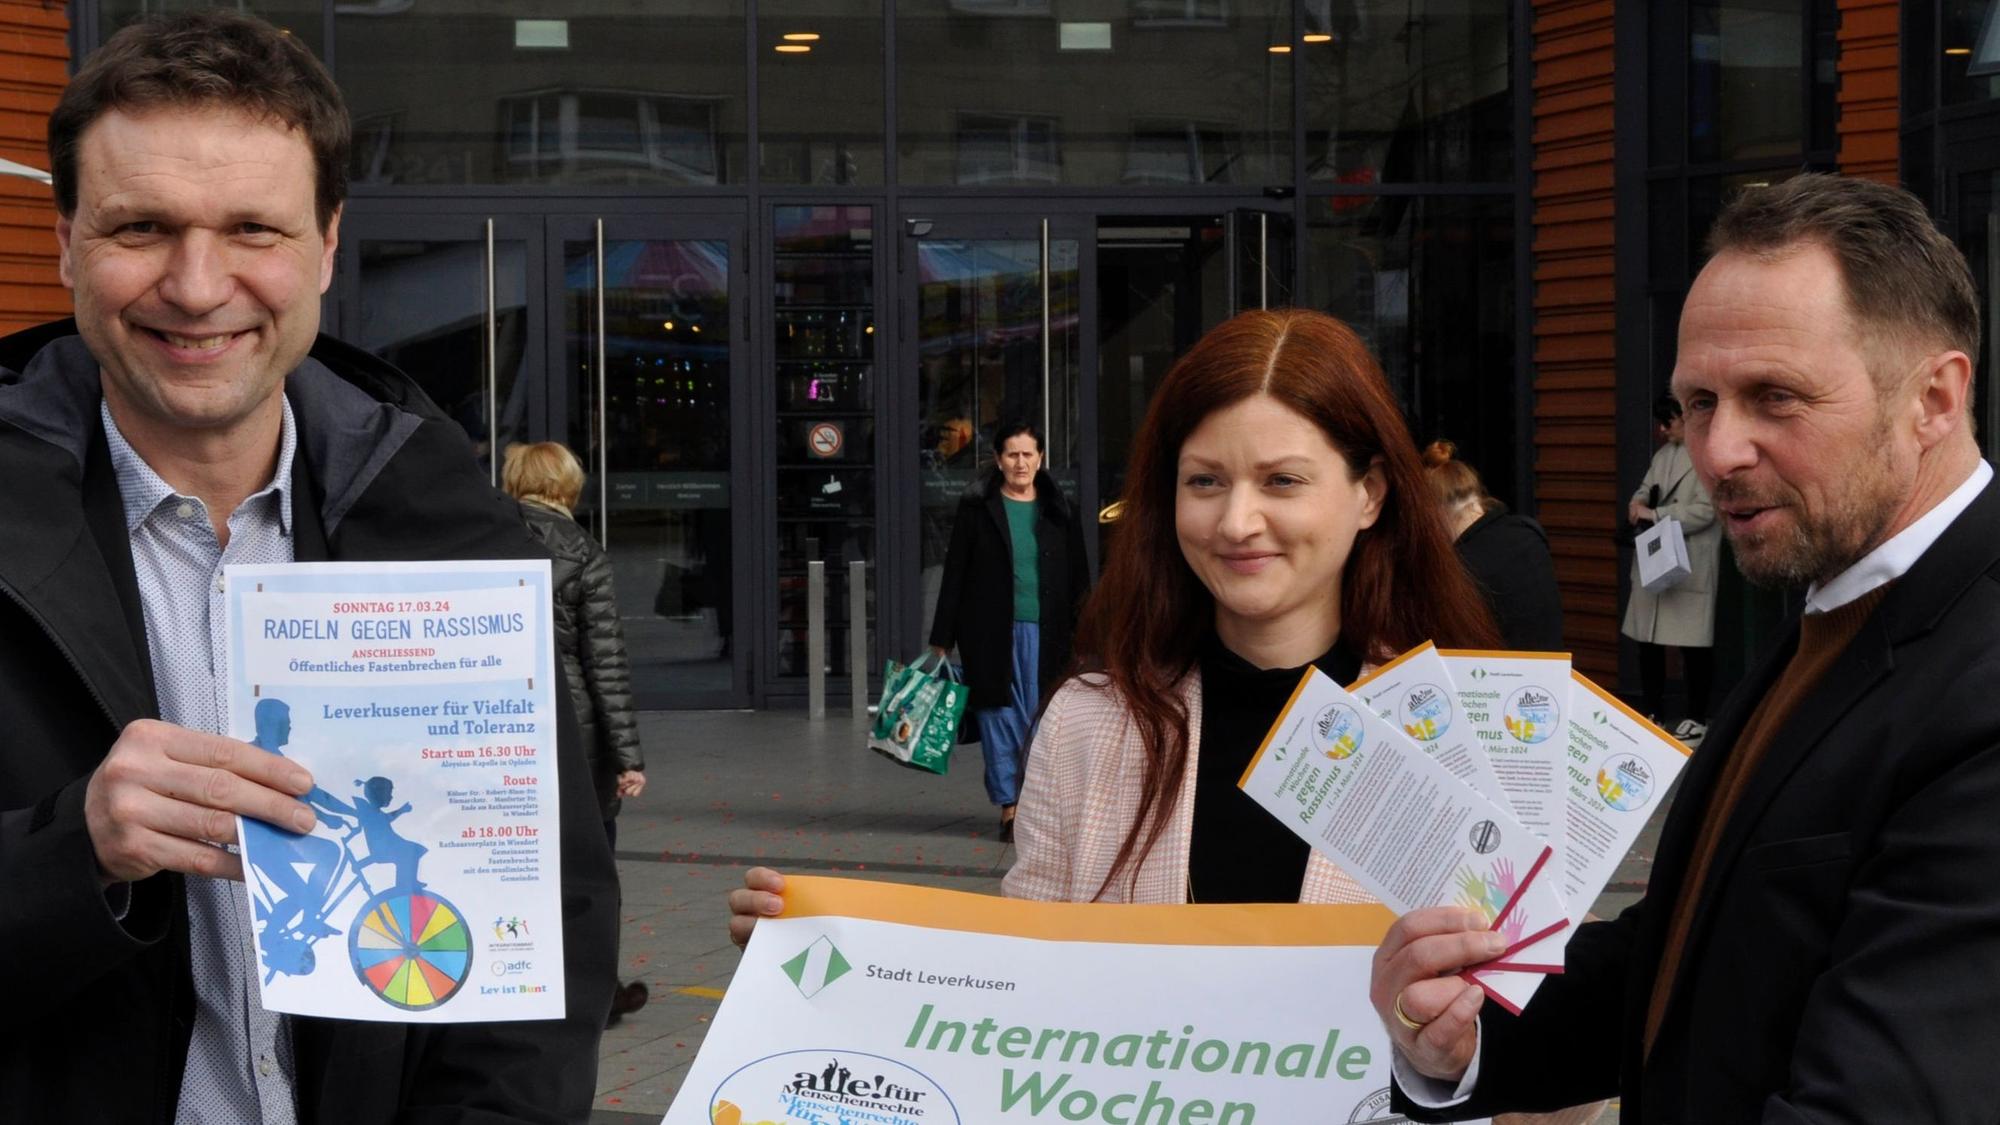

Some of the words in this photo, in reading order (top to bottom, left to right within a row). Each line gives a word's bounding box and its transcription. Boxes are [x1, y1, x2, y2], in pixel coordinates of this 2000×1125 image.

[333, 601, 394, 613] SONNTAG
[398, 601, 450, 613] 17.03.24
[264, 619, 338, 640] RADELN
[351, 618, 411, 640] GEGEN
[423, 613, 524, 638] RASSISMUS
[352, 648, 436, 659] ANSCHLIESSEND
[289, 658, 365, 673] Öffentliches
[368, 659, 457, 673] Fastenbrechen
[459, 657, 478, 669] für
[481, 656, 502, 667] alle
[323, 703, 439, 719] Leverkusener
[443, 701, 469, 716] für
[473, 699, 534, 715] Vielfalt
[1461, 699, 1488, 709] ochen
[1466, 712, 1490, 724] gen
[427, 721, 459, 736] und
[463, 719, 535, 735] Toleranz
[1424, 743, 1439, 754] 024
[1568, 729, 1592, 752] ochen
[421, 748, 453, 759] Start
[456, 750, 475, 758] um
[479, 746, 511, 757] 16.30
[514, 745, 537, 756] Uhr
[1488, 745, 1508, 753] März
[1510, 745, 1528, 754] 2024
[1567, 744, 1589, 764] gen
[508, 759, 537, 767] Opladen
[1351, 752, 1365, 771] 2024
[503, 775, 538, 786] Route
[1274, 746, 1309, 799] Internationale
[1287, 762, 1311, 792] Wochen
[1296, 767, 1321, 806] gegen
[1299, 765, 1342, 825] Rassismus
[1587, 797, 1606, 812] 2024
[461, 827, 476, 838] ab
[479, 827, 512, 837] 18.00
[516, 826, 539, 837] Uhr
[507, 960, 532, 970] adfc
[865, 963, 916, 985] Stadt
[918, 970, 1017, 992] Leverkusen
[480, 986, 499, 994] Lev
[502, 985, 516, 993] ist
[519, 984, 547, 993] Bunt
[905, 1003, 1372, 1080] Internationale
[781, 1083, 924, 1117] Menschenrechte
[884, 1082, 926, 1103] für
[999, 1068, 1256, 1125] Wochen
